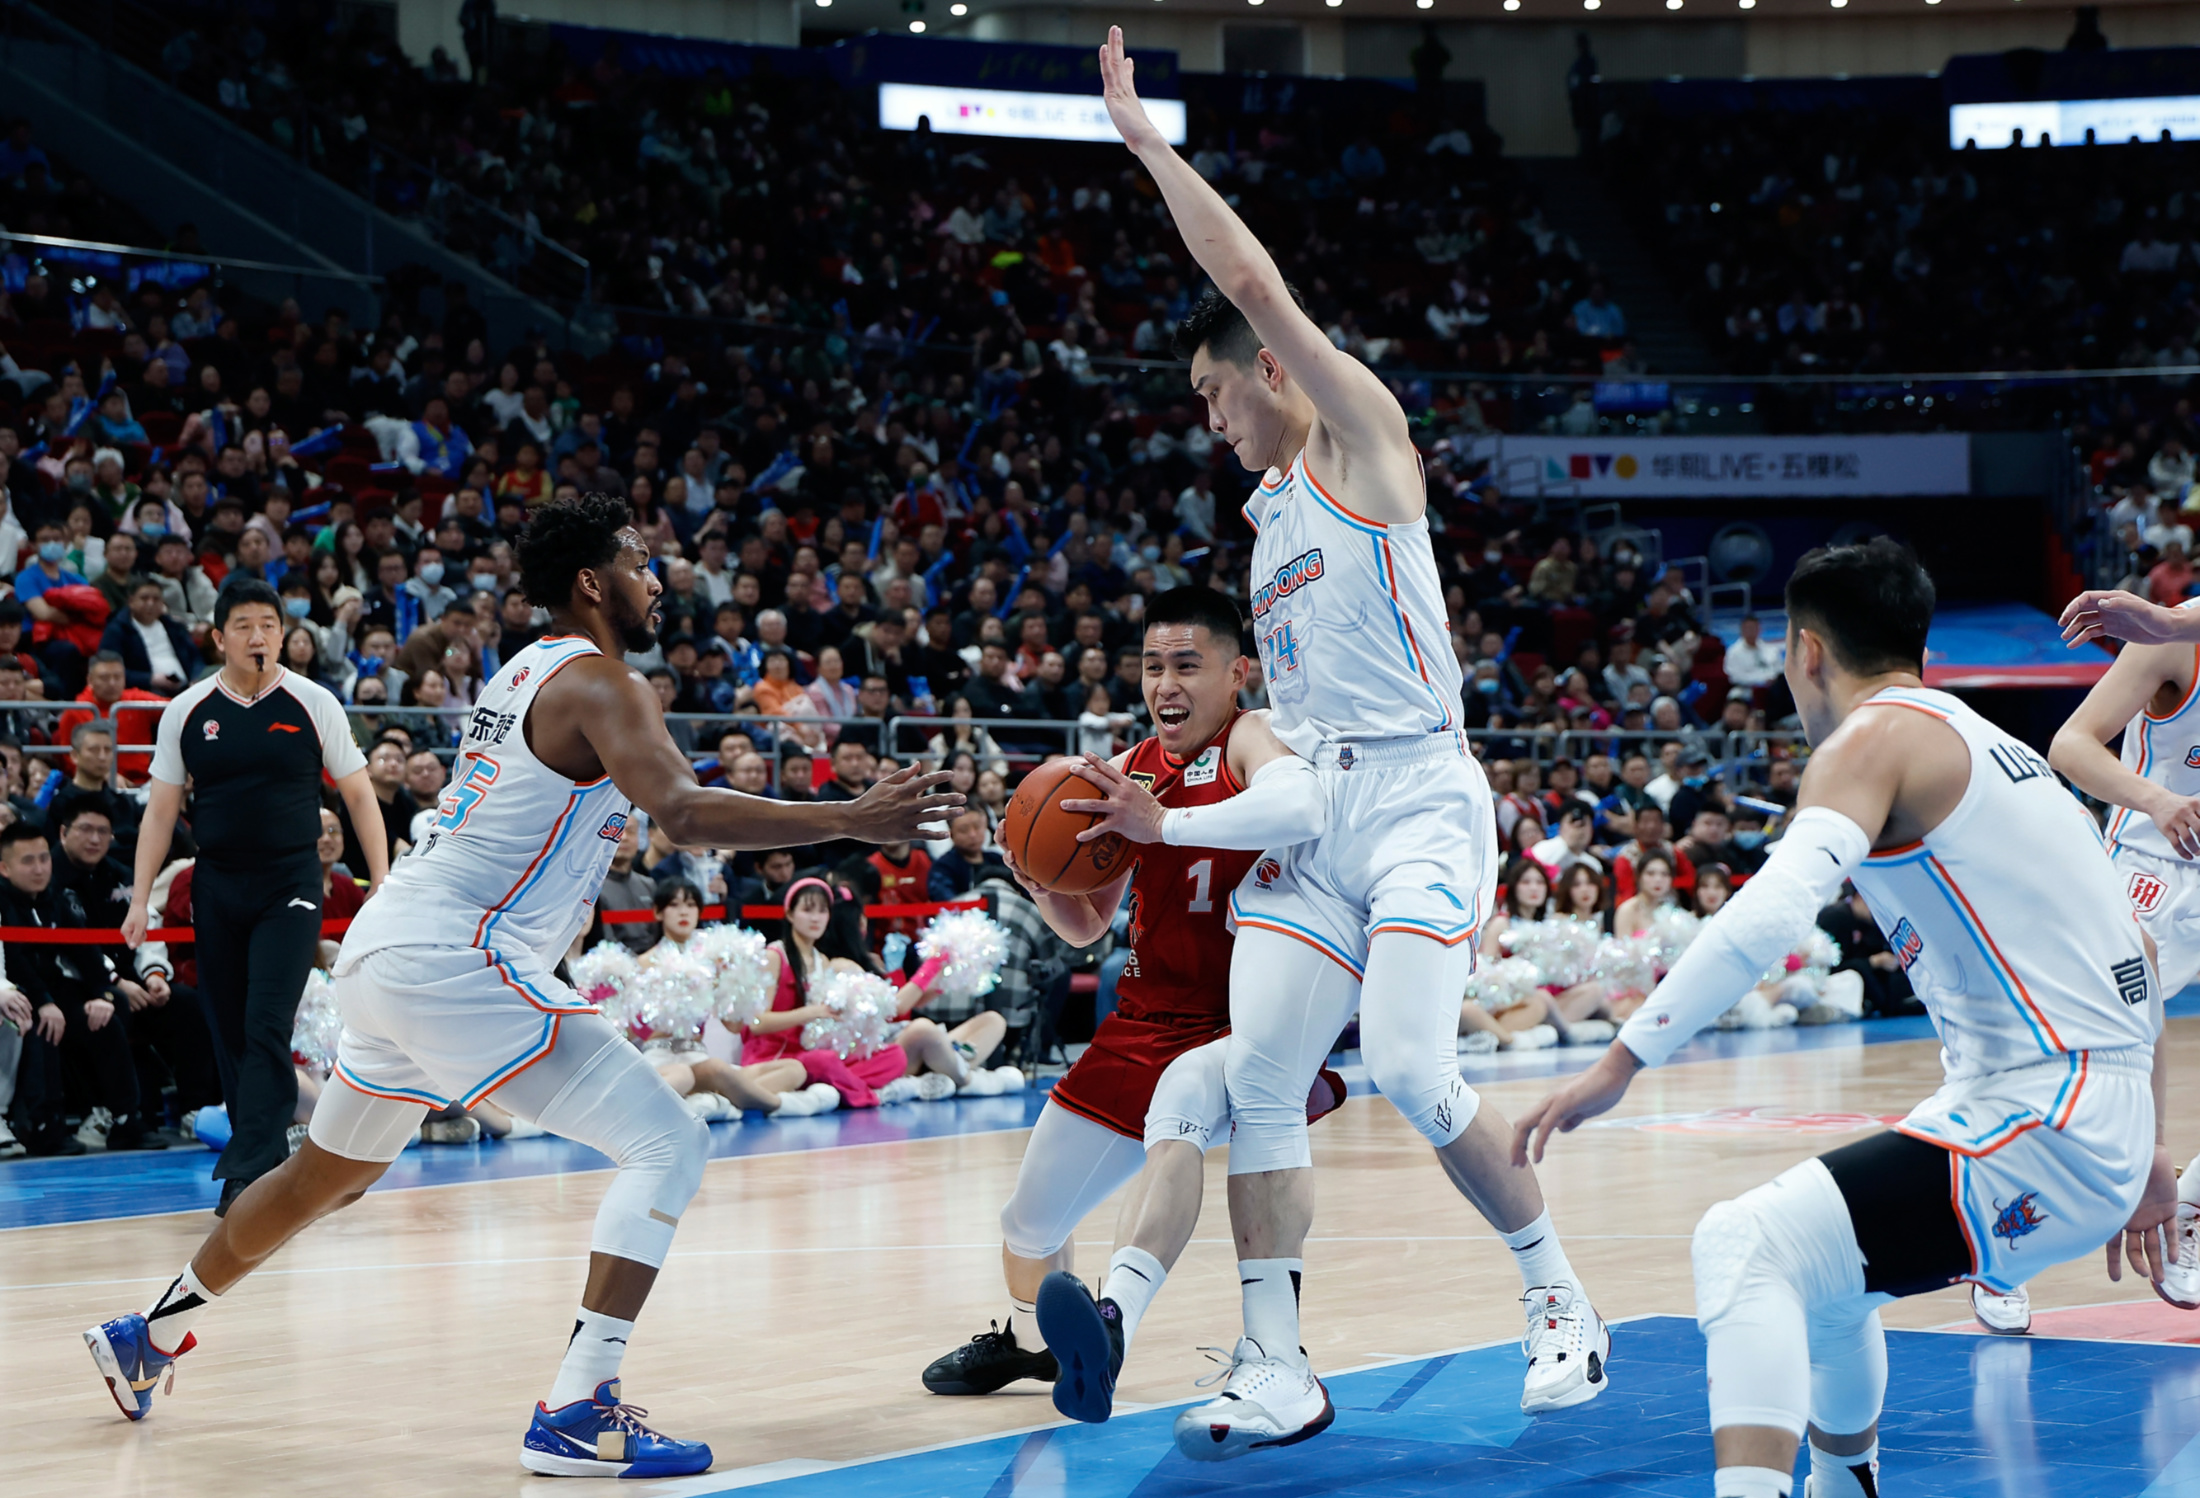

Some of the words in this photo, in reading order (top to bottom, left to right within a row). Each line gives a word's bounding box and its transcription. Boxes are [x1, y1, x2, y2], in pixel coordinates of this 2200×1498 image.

[1263, 620, 1299, 683] 14
[432, 752, 501, 835] 5
[1187, 858, 1214, 912] 1
